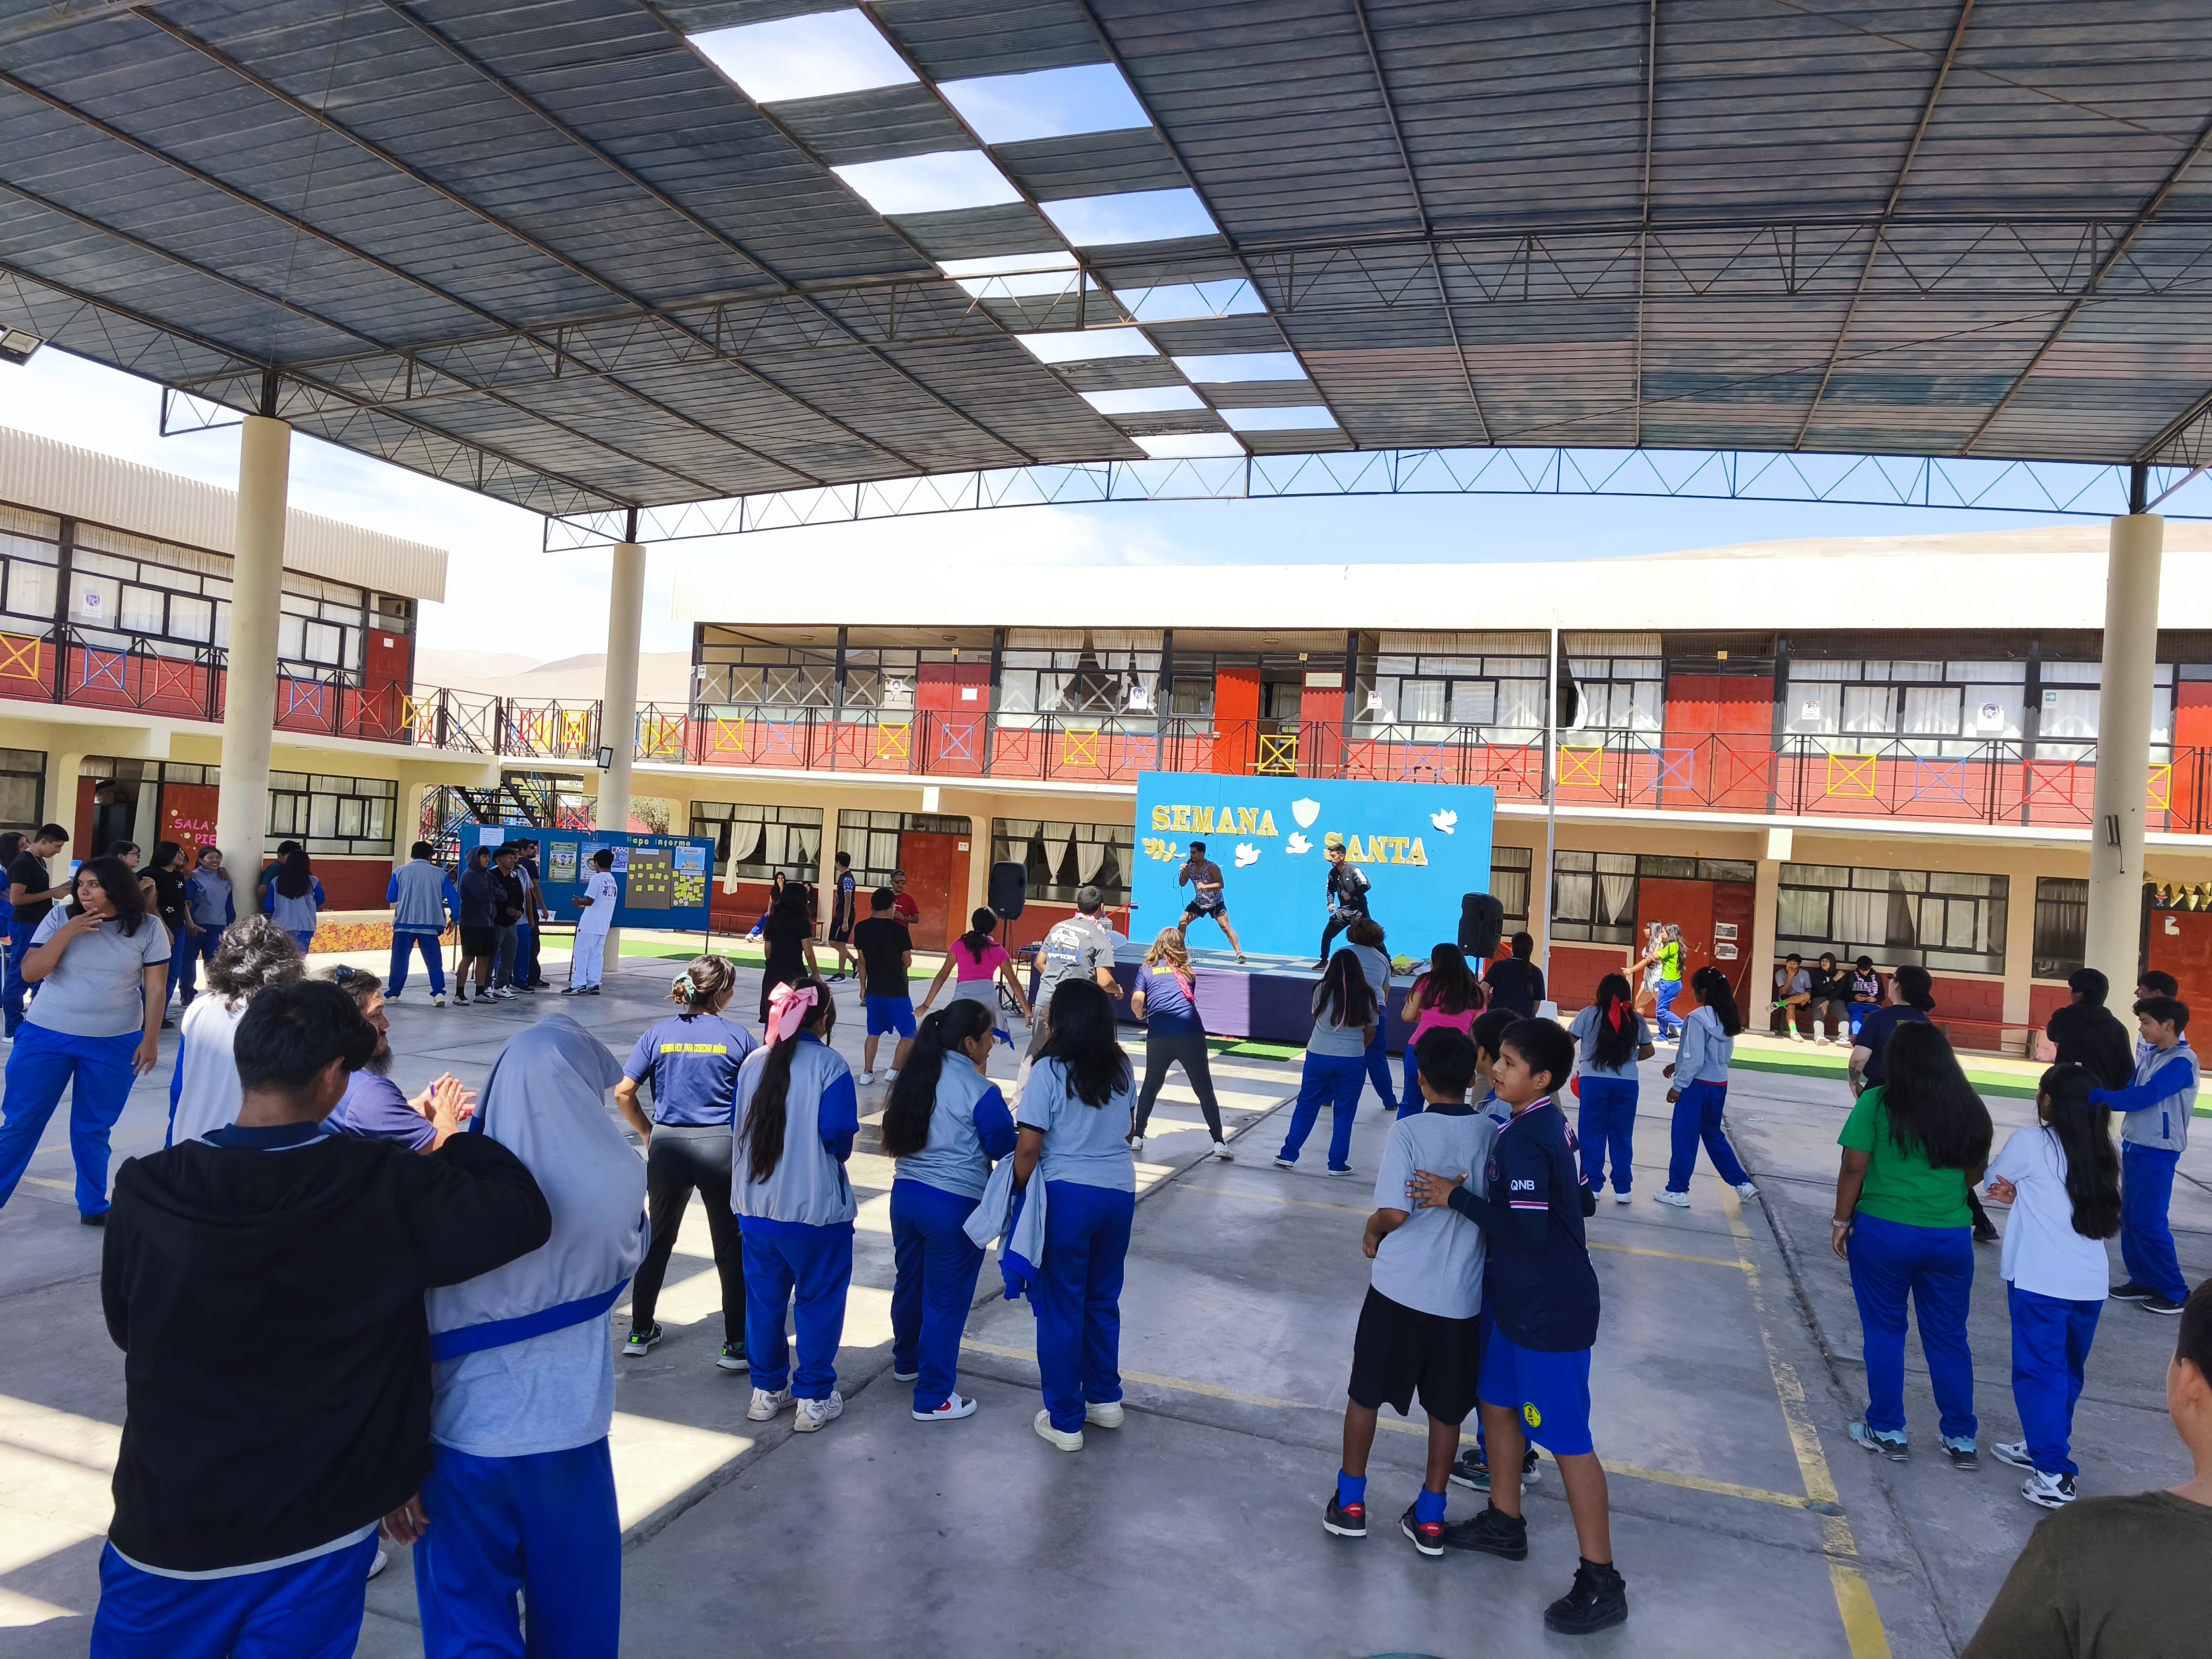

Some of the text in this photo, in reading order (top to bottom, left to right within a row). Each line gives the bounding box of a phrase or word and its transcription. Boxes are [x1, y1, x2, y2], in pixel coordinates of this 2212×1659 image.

[174, 818, 209, 831] SALA
[1151, 805, 1278, 836] SEMANA
[194, 833, 217, 846] PIE
[1323, 831, 1428, 866] SANTA
[684, 1043, 693, 1053] PARA
[1510, 1179, 1535, 1190] QNB
